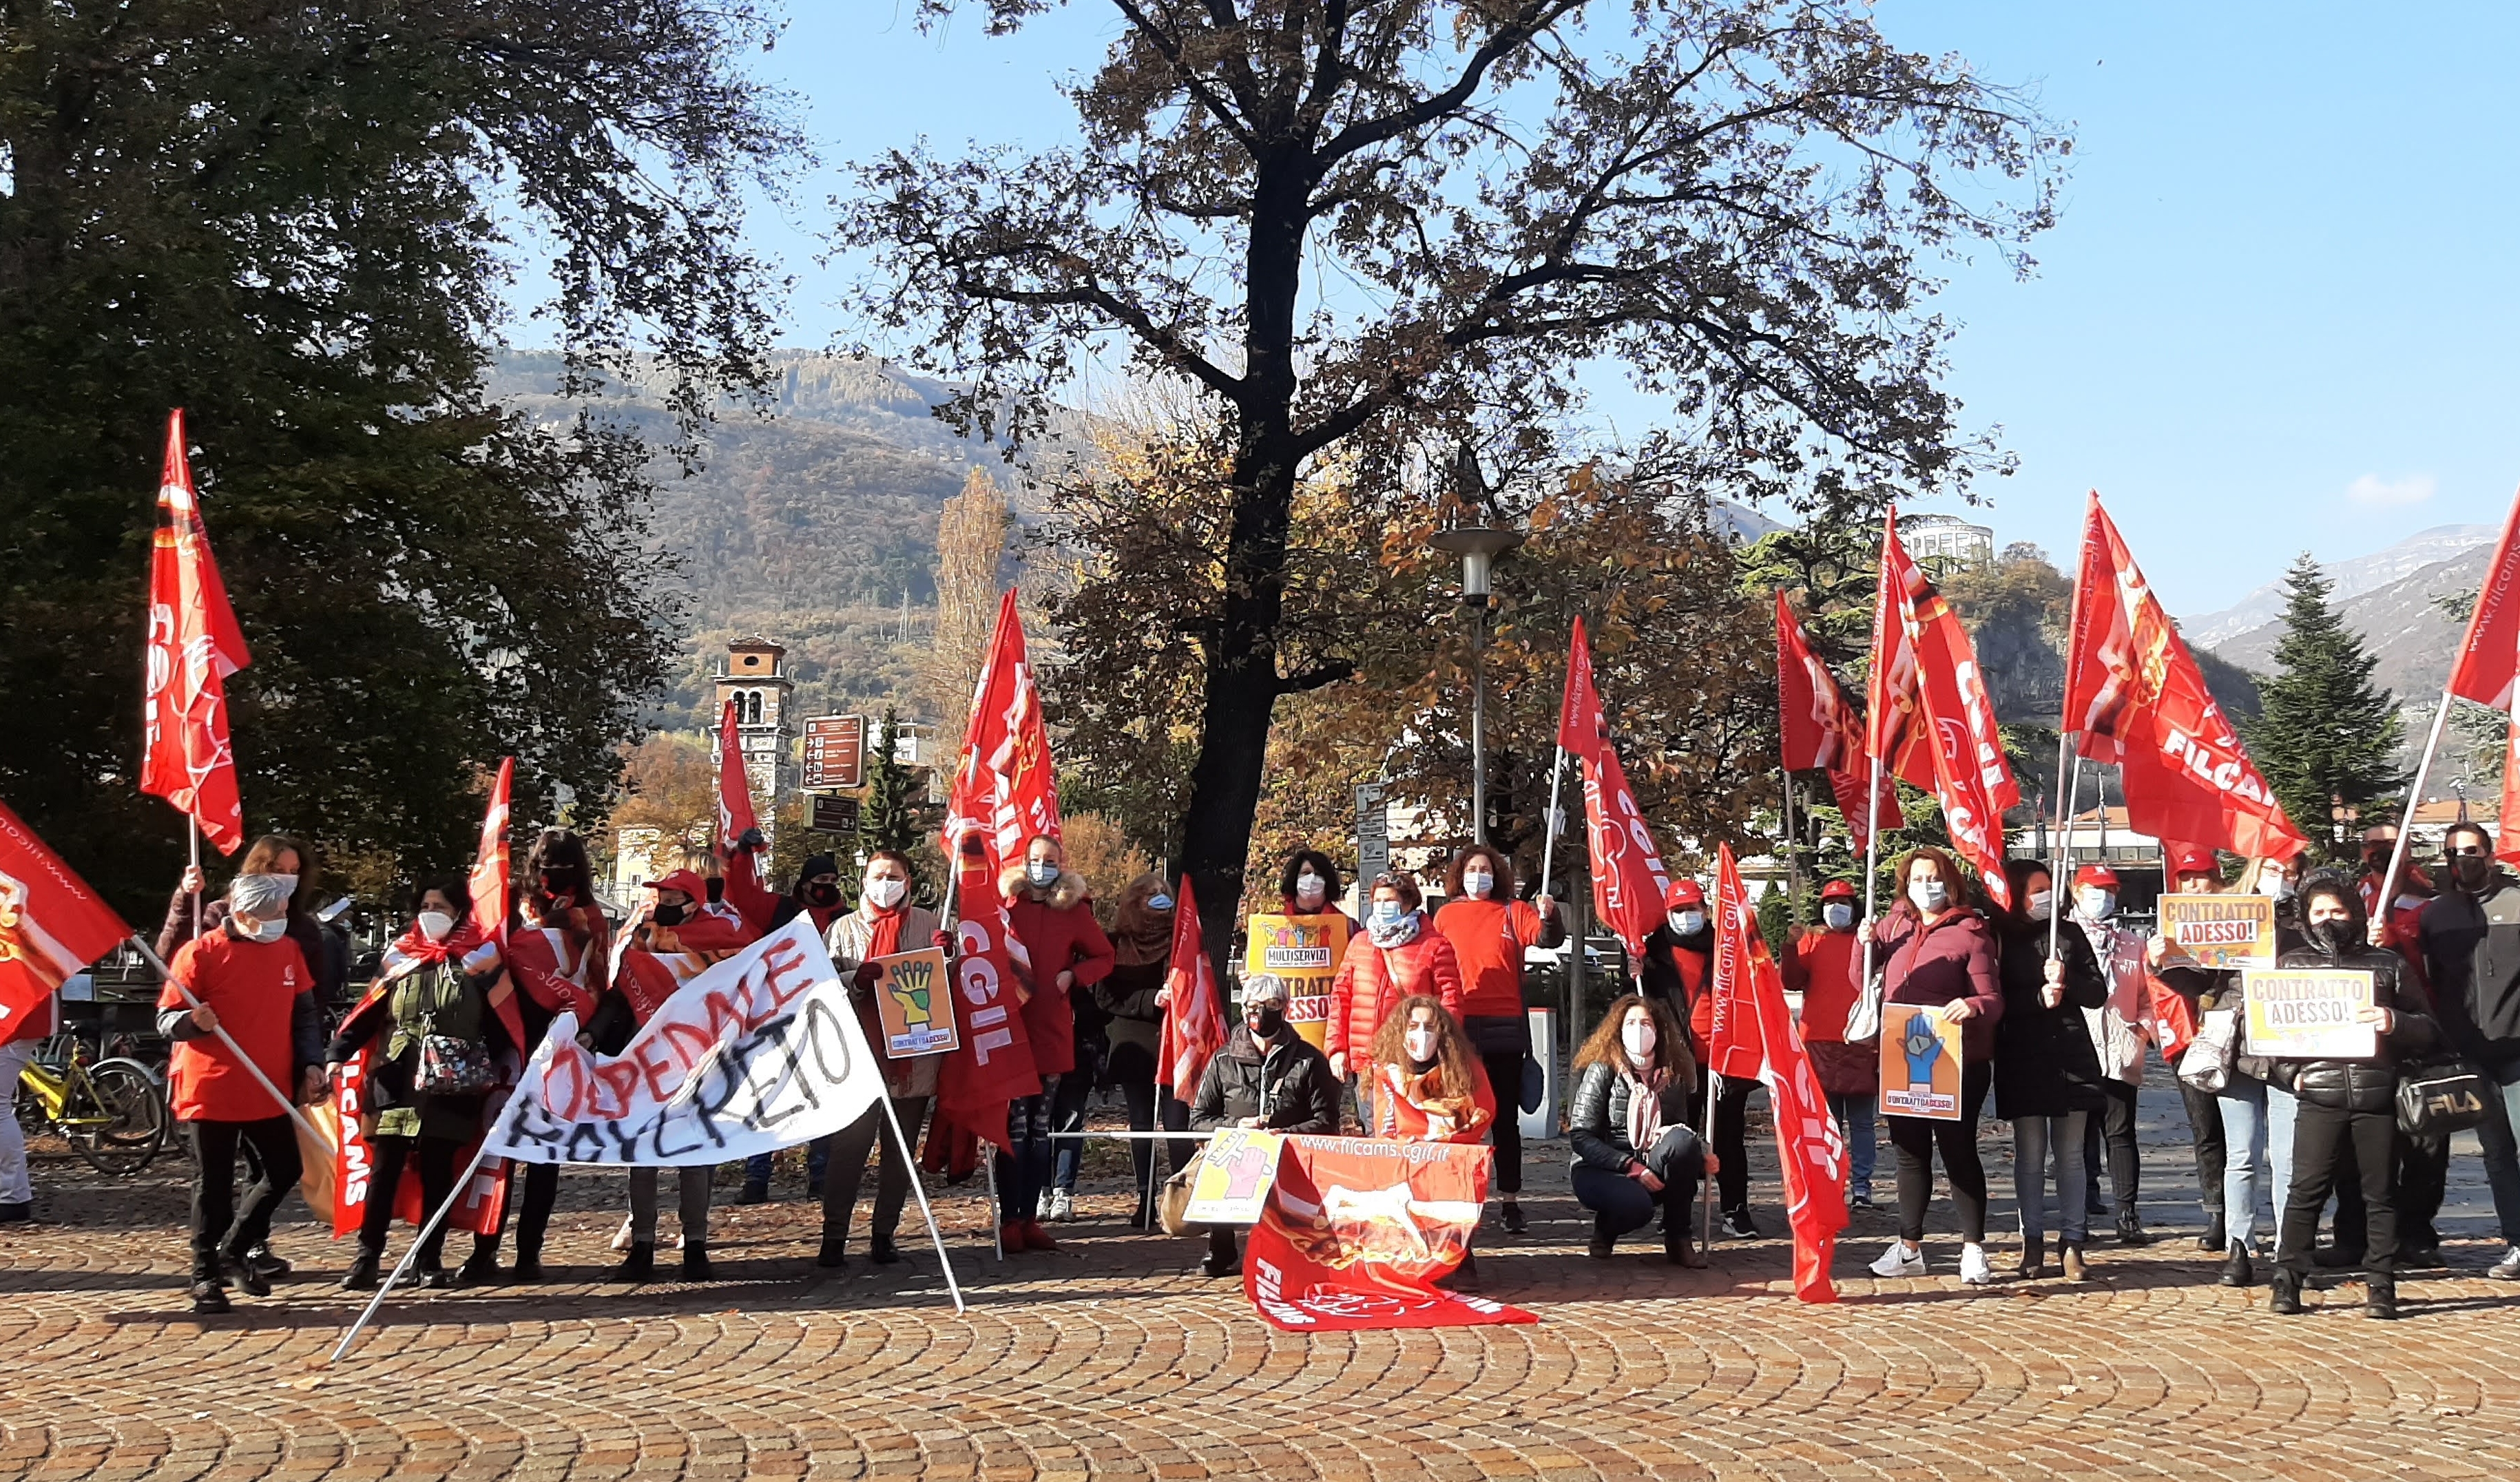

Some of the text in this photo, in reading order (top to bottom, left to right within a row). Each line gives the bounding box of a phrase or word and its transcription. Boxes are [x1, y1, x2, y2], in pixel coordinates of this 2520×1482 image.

[2165, 903, 2267, 922] CONTRATTO
[2181, 922, 2253, 943] ADESSO!
[1269, 949, 1326, 961] MULTISERVIZI
[957, 919, 1012, 1067] CGIL
[2253, 979, 2364, 1001] CONTRATTO
[2273, 1001, 2350, 1024] ADESSO!
[2426, 1091, 2482, 1117] FILA
[1299, 1136, 1451, 1163] www.filcams.cgil.it
